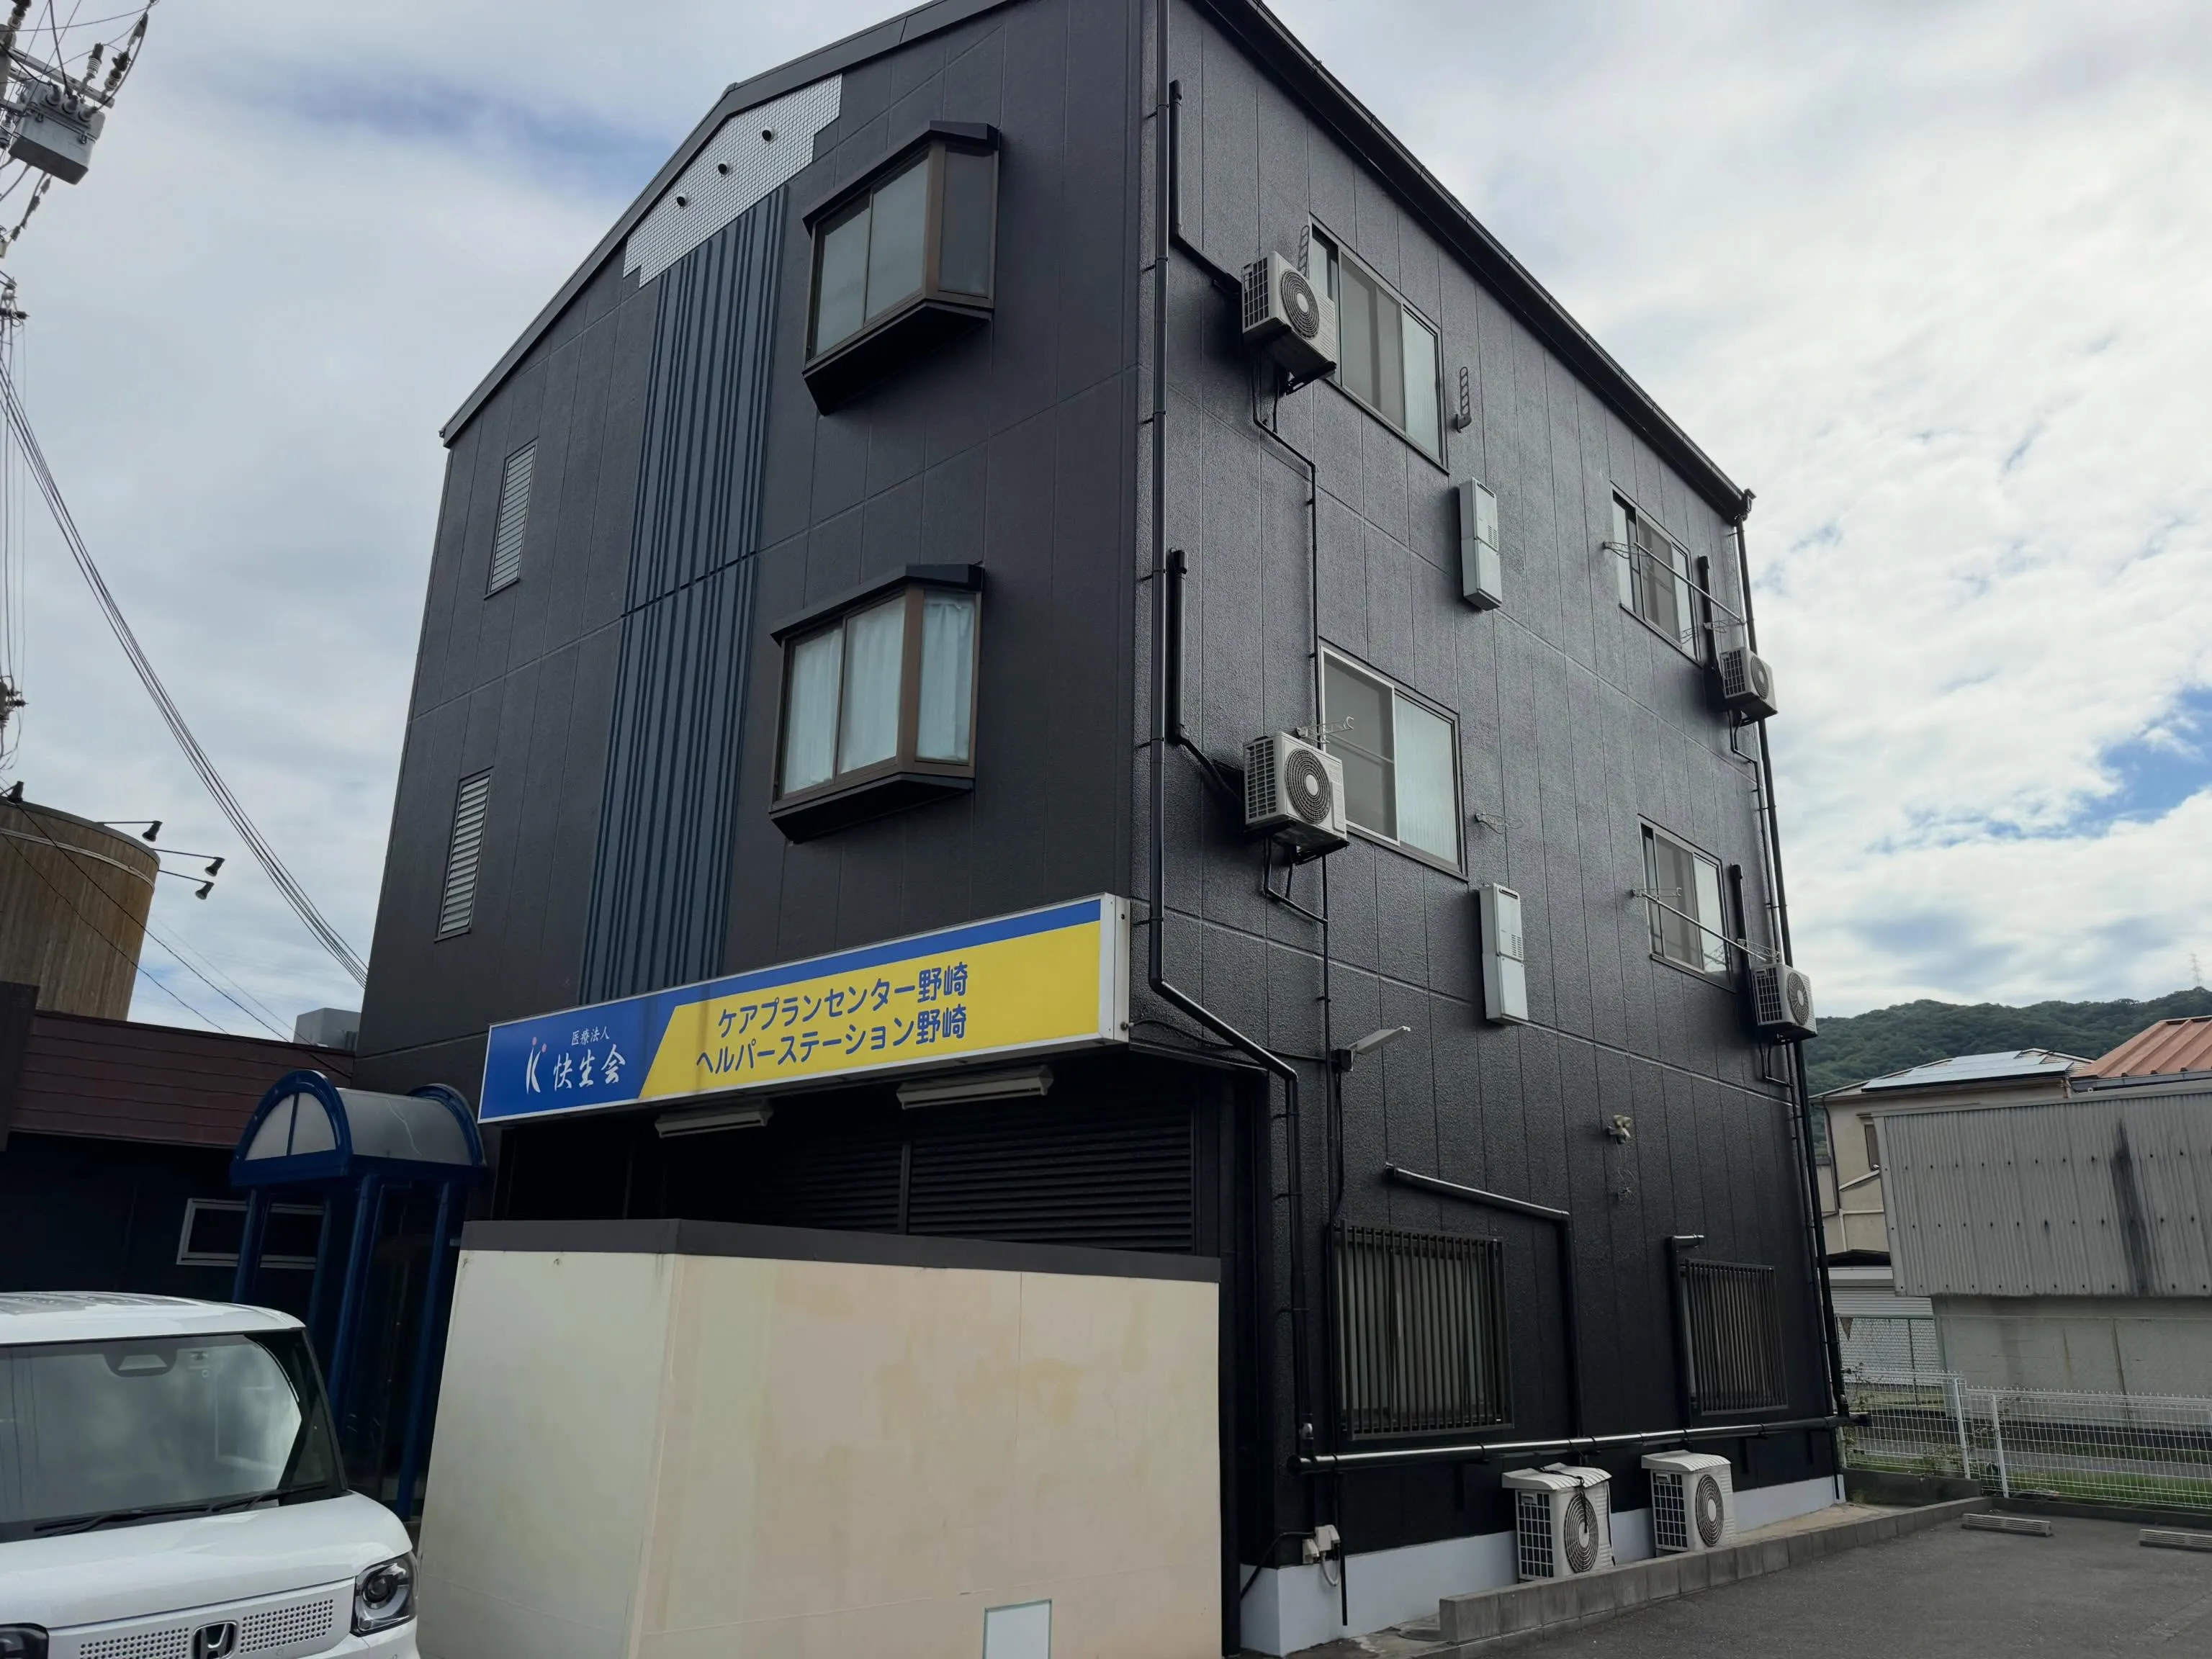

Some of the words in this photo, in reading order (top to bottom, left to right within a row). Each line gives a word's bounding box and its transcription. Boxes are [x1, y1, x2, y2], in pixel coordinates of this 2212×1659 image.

[718, 961, 968, 1038] ケアプランセンター野崎
[571, 1025, 610, 1046] 医療法人
[696, 1004, 967, 1074] ヘルパーステーション野崎
[553, 1043, 626, 1092] 快生会
